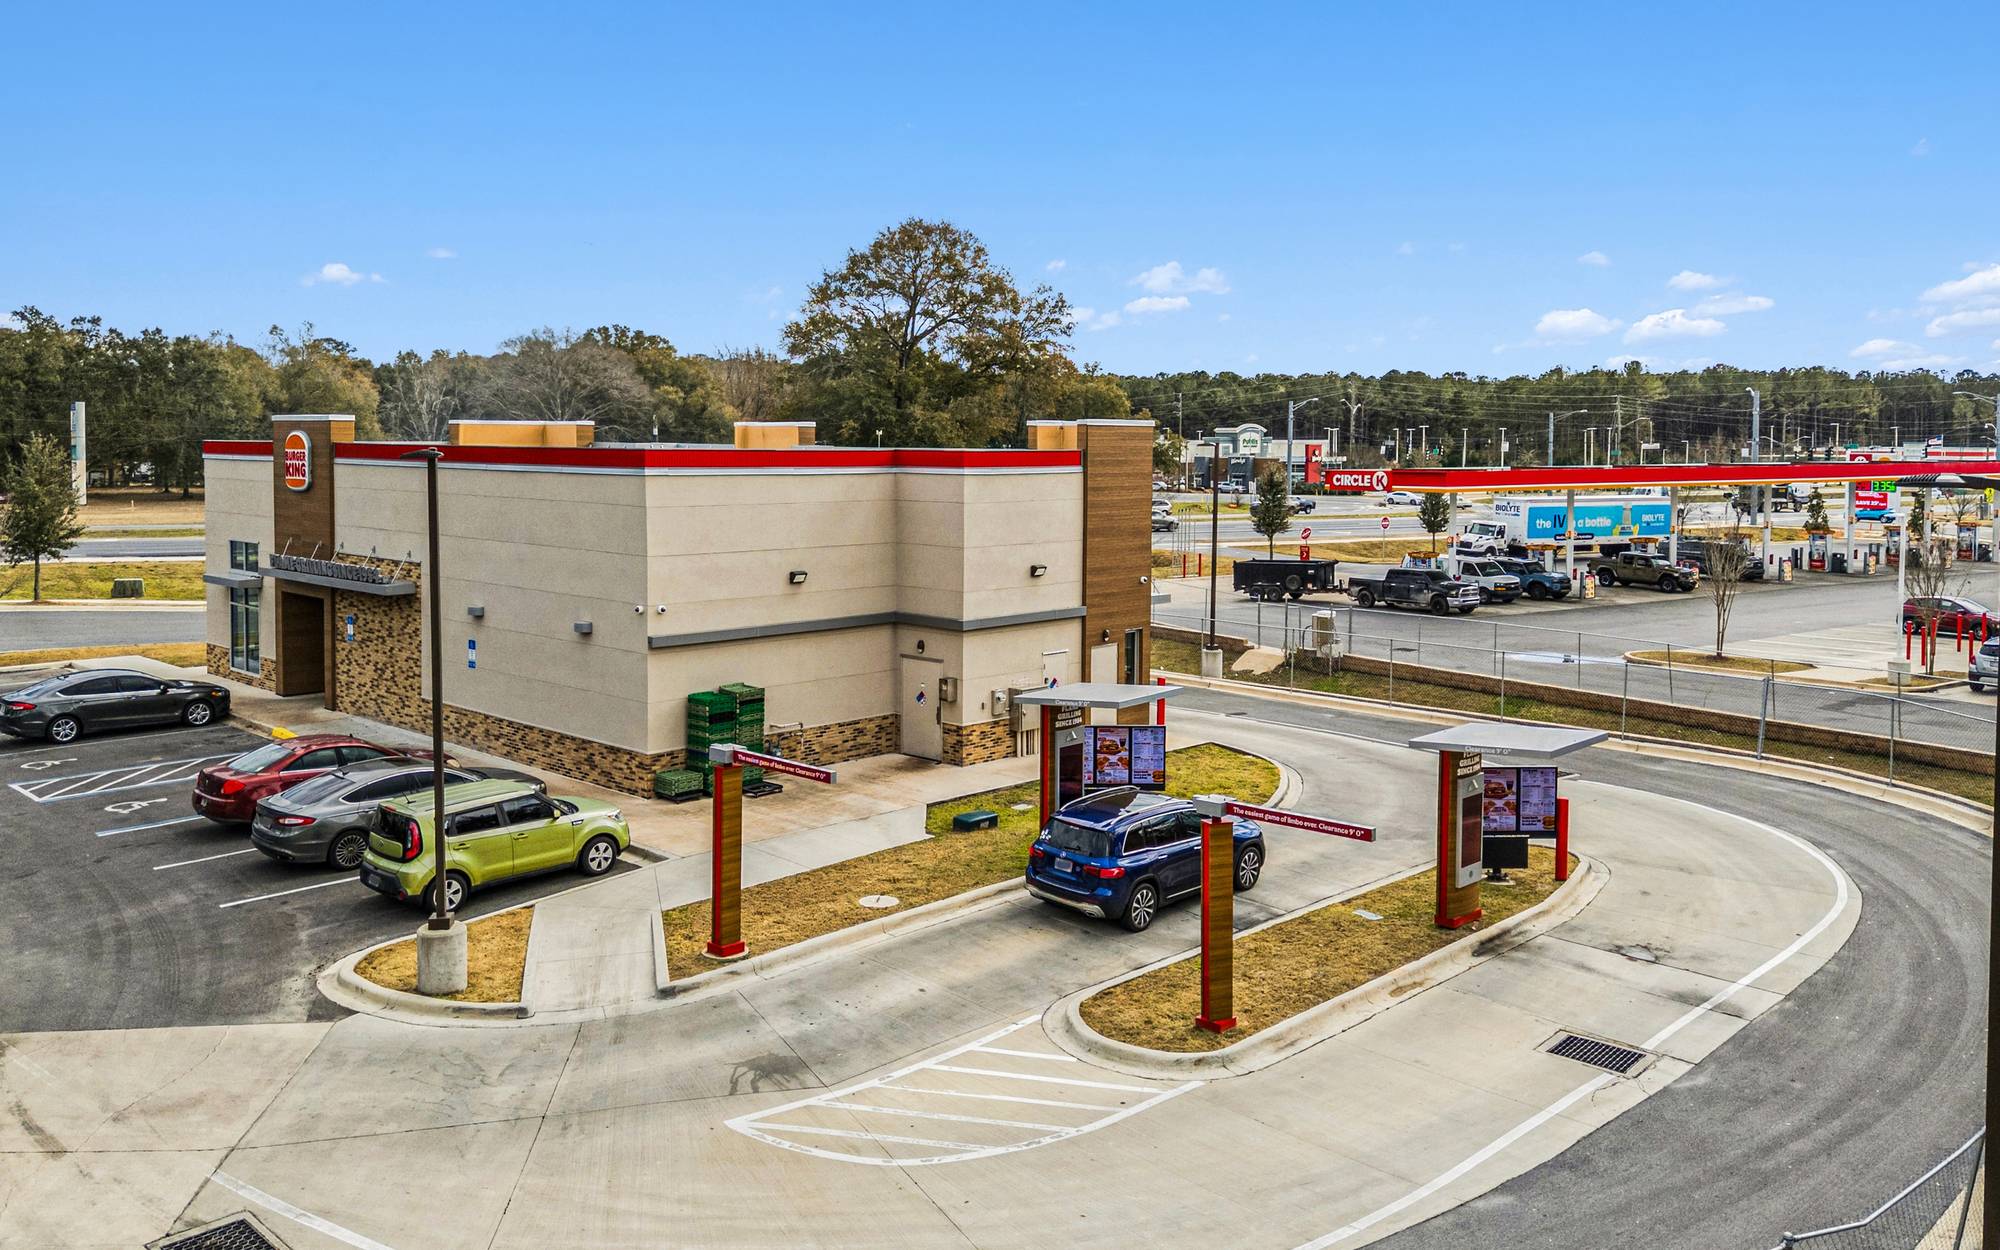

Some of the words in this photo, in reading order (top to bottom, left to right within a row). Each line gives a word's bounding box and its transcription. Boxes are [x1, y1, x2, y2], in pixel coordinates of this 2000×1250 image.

[285, 451, 306, 461] BURGER
[286, 462, 306, 478] KING
[1332, 474, 1371, 487] CIRCLE
[1374, 473, 1387, 490] K
[1495, 503, 1520, 513] BIOLYTE
[1536, 518, 1552, 529] the
[1554, 514, 1566, 528] IV
[1577, 519, 1583, 528] a
[1585, 516, 1612, 528] bottle
[1233, 806, 1244, 815] The
[1244, 809, 1265, 819] easiest
[1264, 813, 1280, 821] game
[1280, 815, 1288, 823] of
[1287, 817, 1304, 826] limbo
[1318, 822, 1349, 835] Clearance
